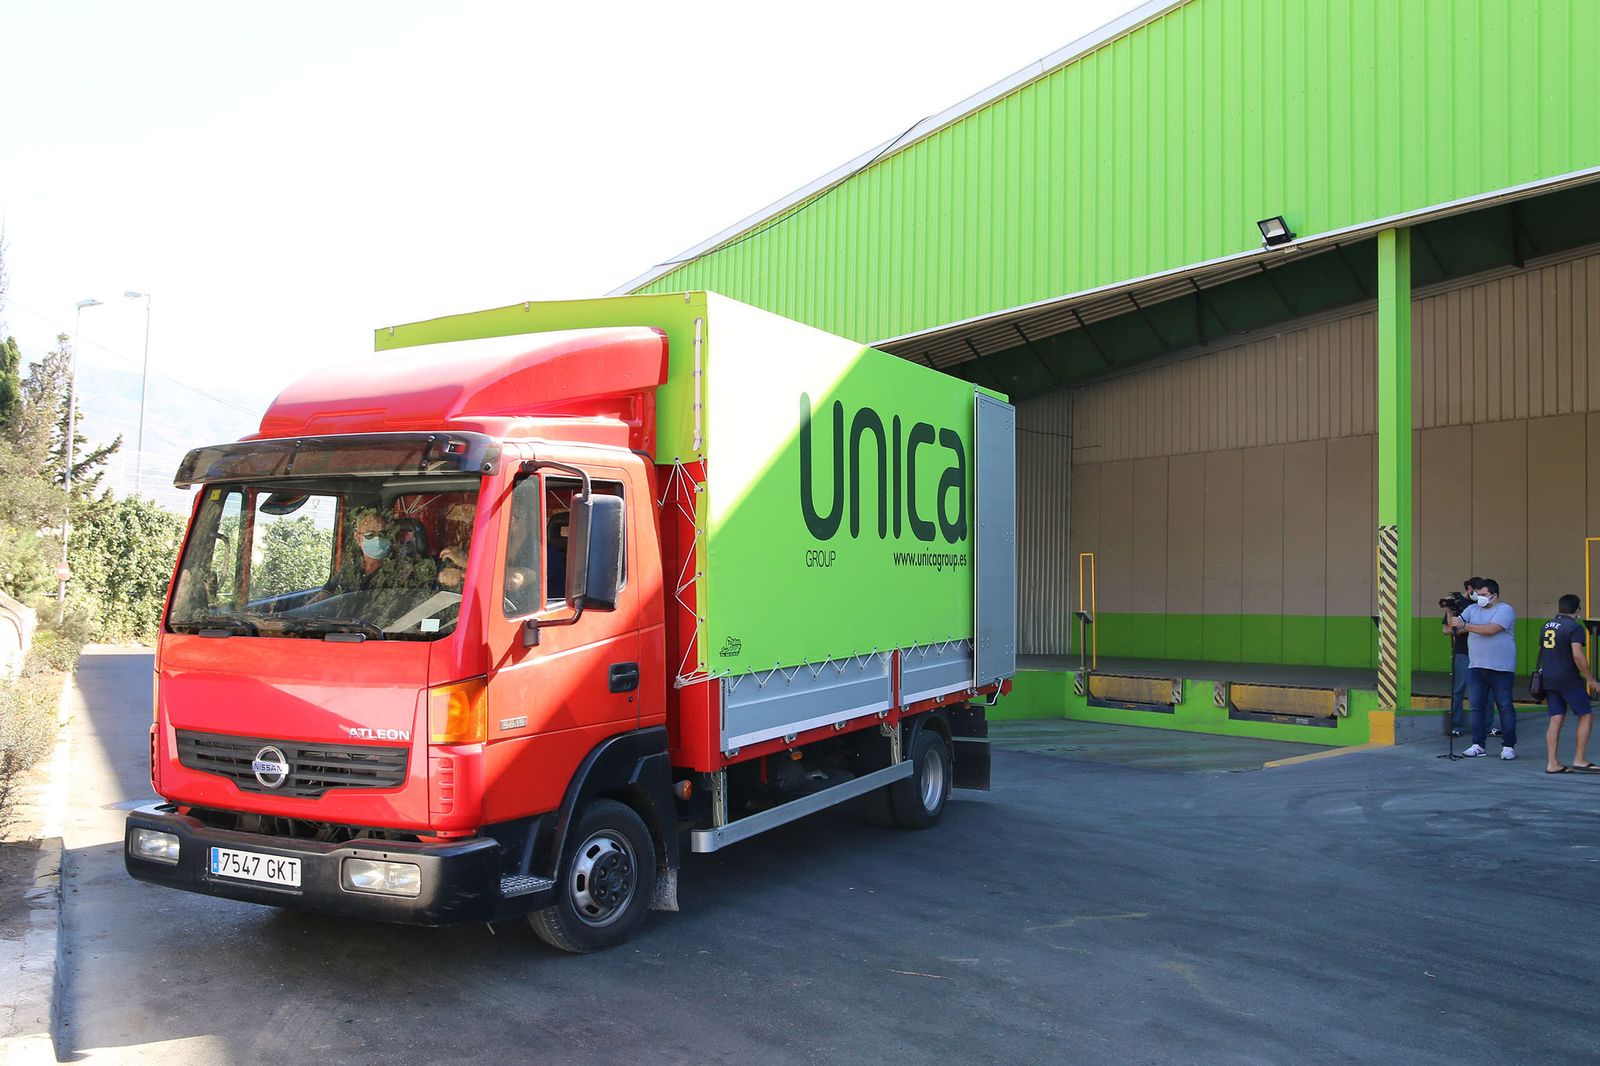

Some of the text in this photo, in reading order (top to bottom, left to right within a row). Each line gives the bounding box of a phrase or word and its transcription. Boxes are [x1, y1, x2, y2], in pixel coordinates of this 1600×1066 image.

[805, 549, 838, 568] GROUP
[893, 547, 968, 572] www.unicagroup.es
[1543, 629, 1556, 649] 3
[349, 727, 411, 741] ATLEON
[222, 852, 260, 876] 7547
[266, 859, 297, 882] GKT
